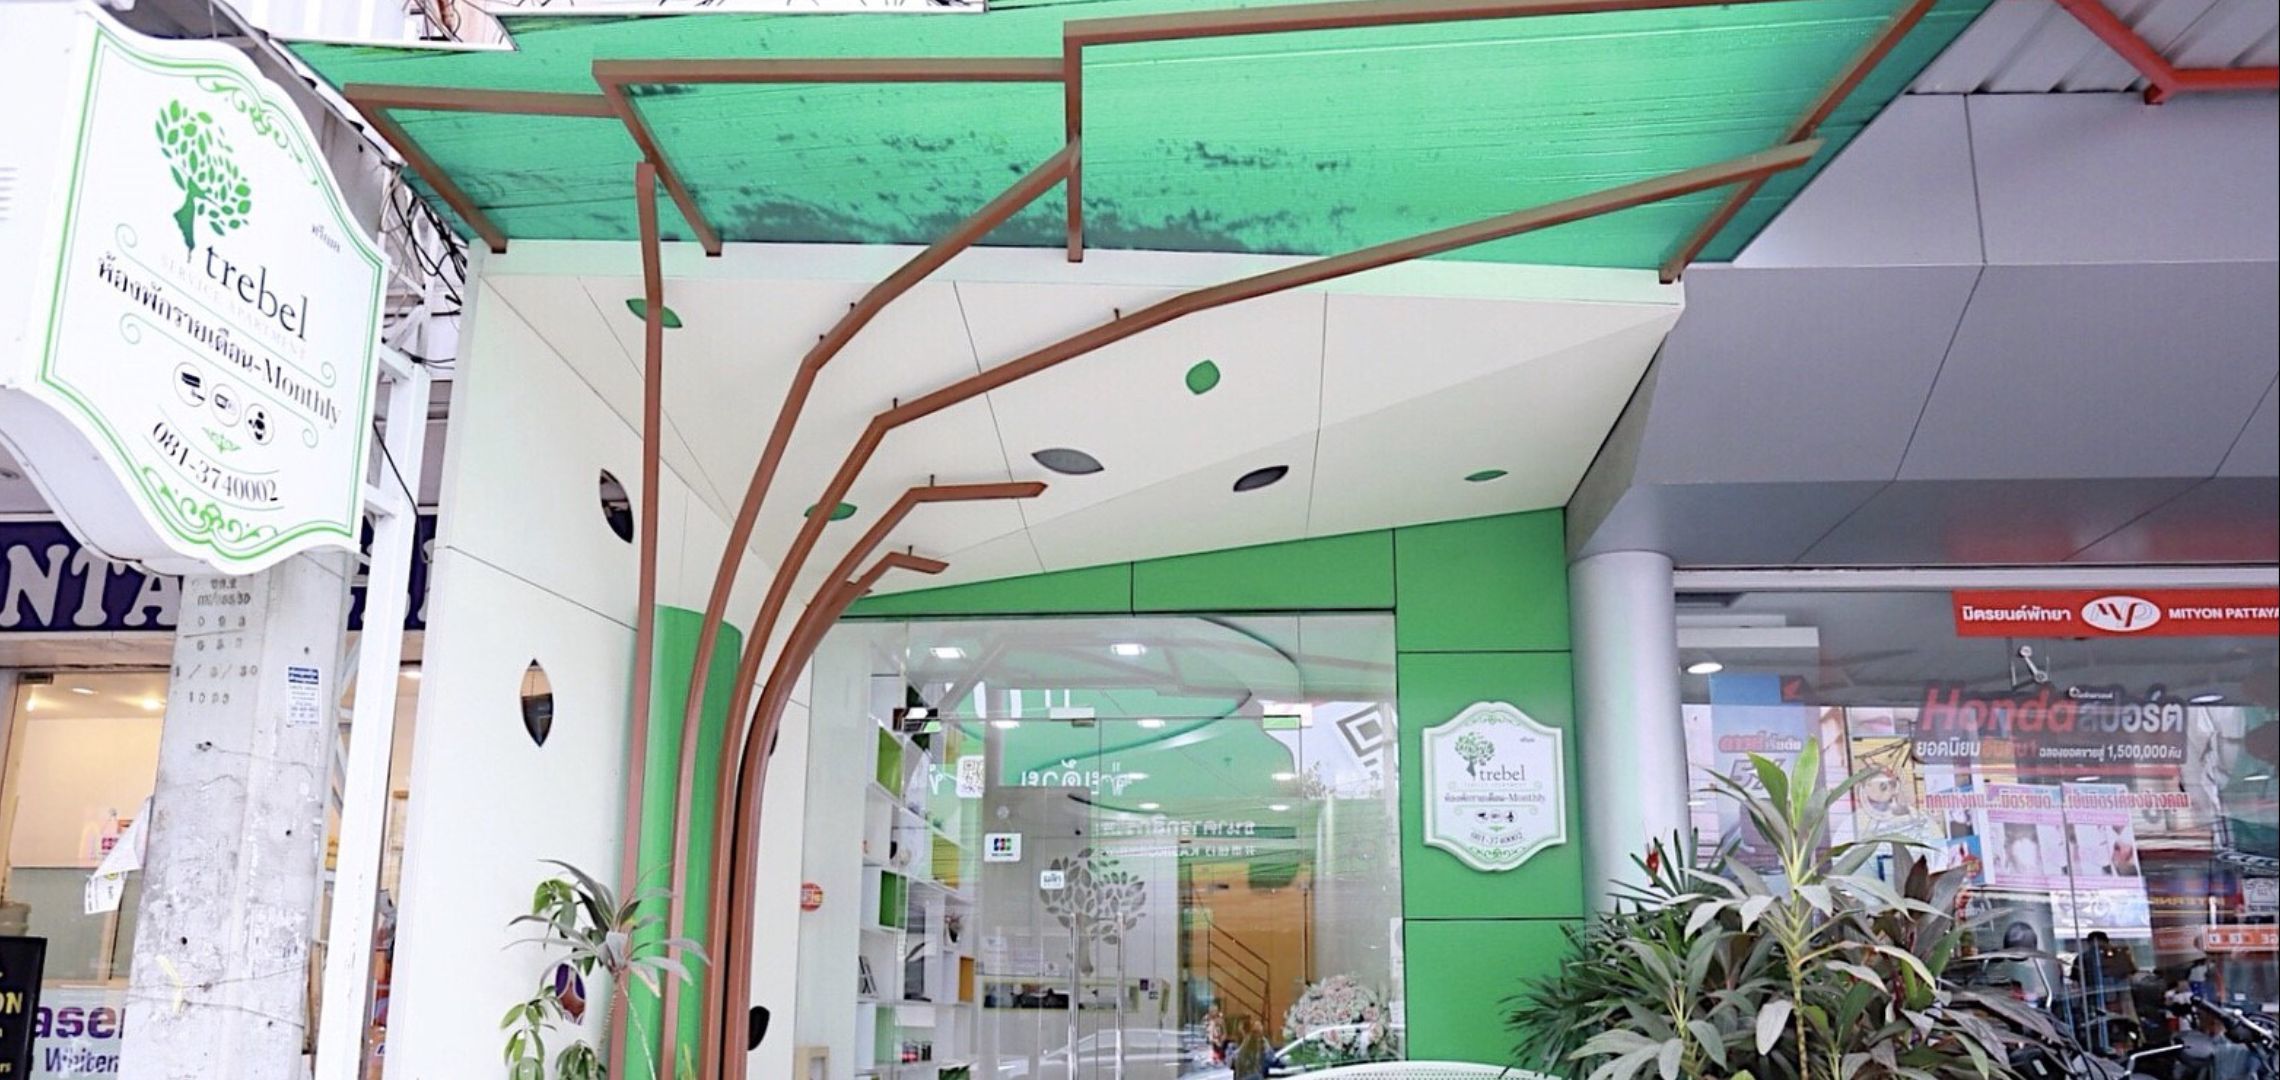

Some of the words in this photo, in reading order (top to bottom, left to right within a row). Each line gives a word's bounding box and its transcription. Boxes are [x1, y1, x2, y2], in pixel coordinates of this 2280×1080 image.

[206, 245, 308, 341] trebel
[153, 422, 278, 502] 081-3740002
[2168, 607, 2222, 620] MITYON
[1921, 685, 2078, 733] Honda
[2106, 744, 2168, 761] 1,500,000
[1479, 764, 1525, 781] trebel
